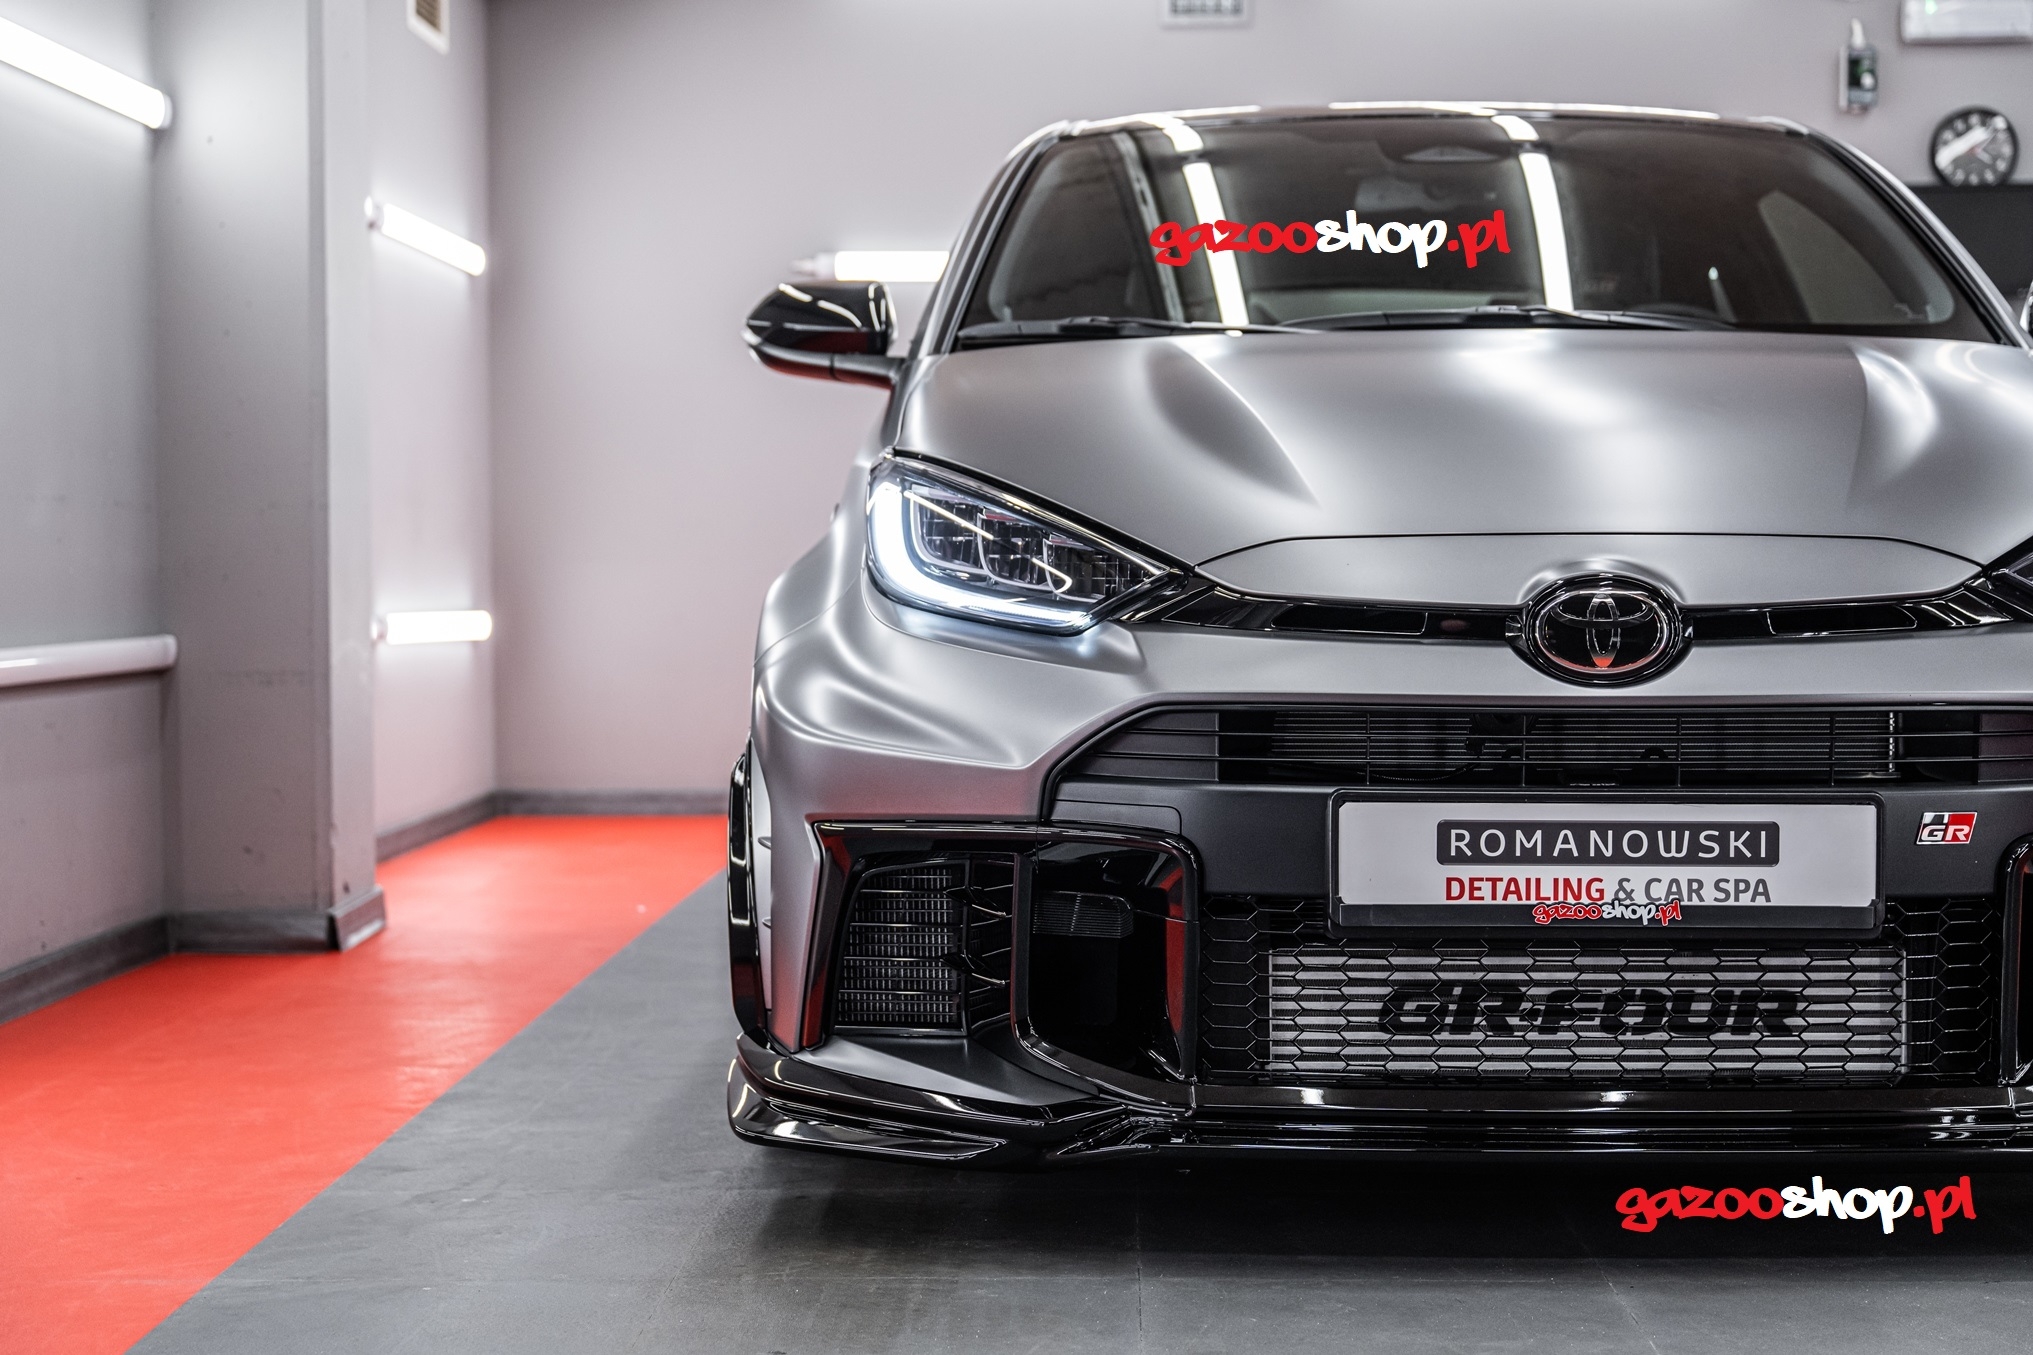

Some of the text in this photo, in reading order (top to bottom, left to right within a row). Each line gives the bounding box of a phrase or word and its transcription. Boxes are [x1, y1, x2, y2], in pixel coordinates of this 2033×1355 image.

[1450, 829, 1767, 858] ROMANOWSKI
[1921, 825, 1970, 841] GR
[1445, 877, 1772, 903] DETAILING & CAR SPA
[1532, 900, 1682, 926] gazooshop.pl
